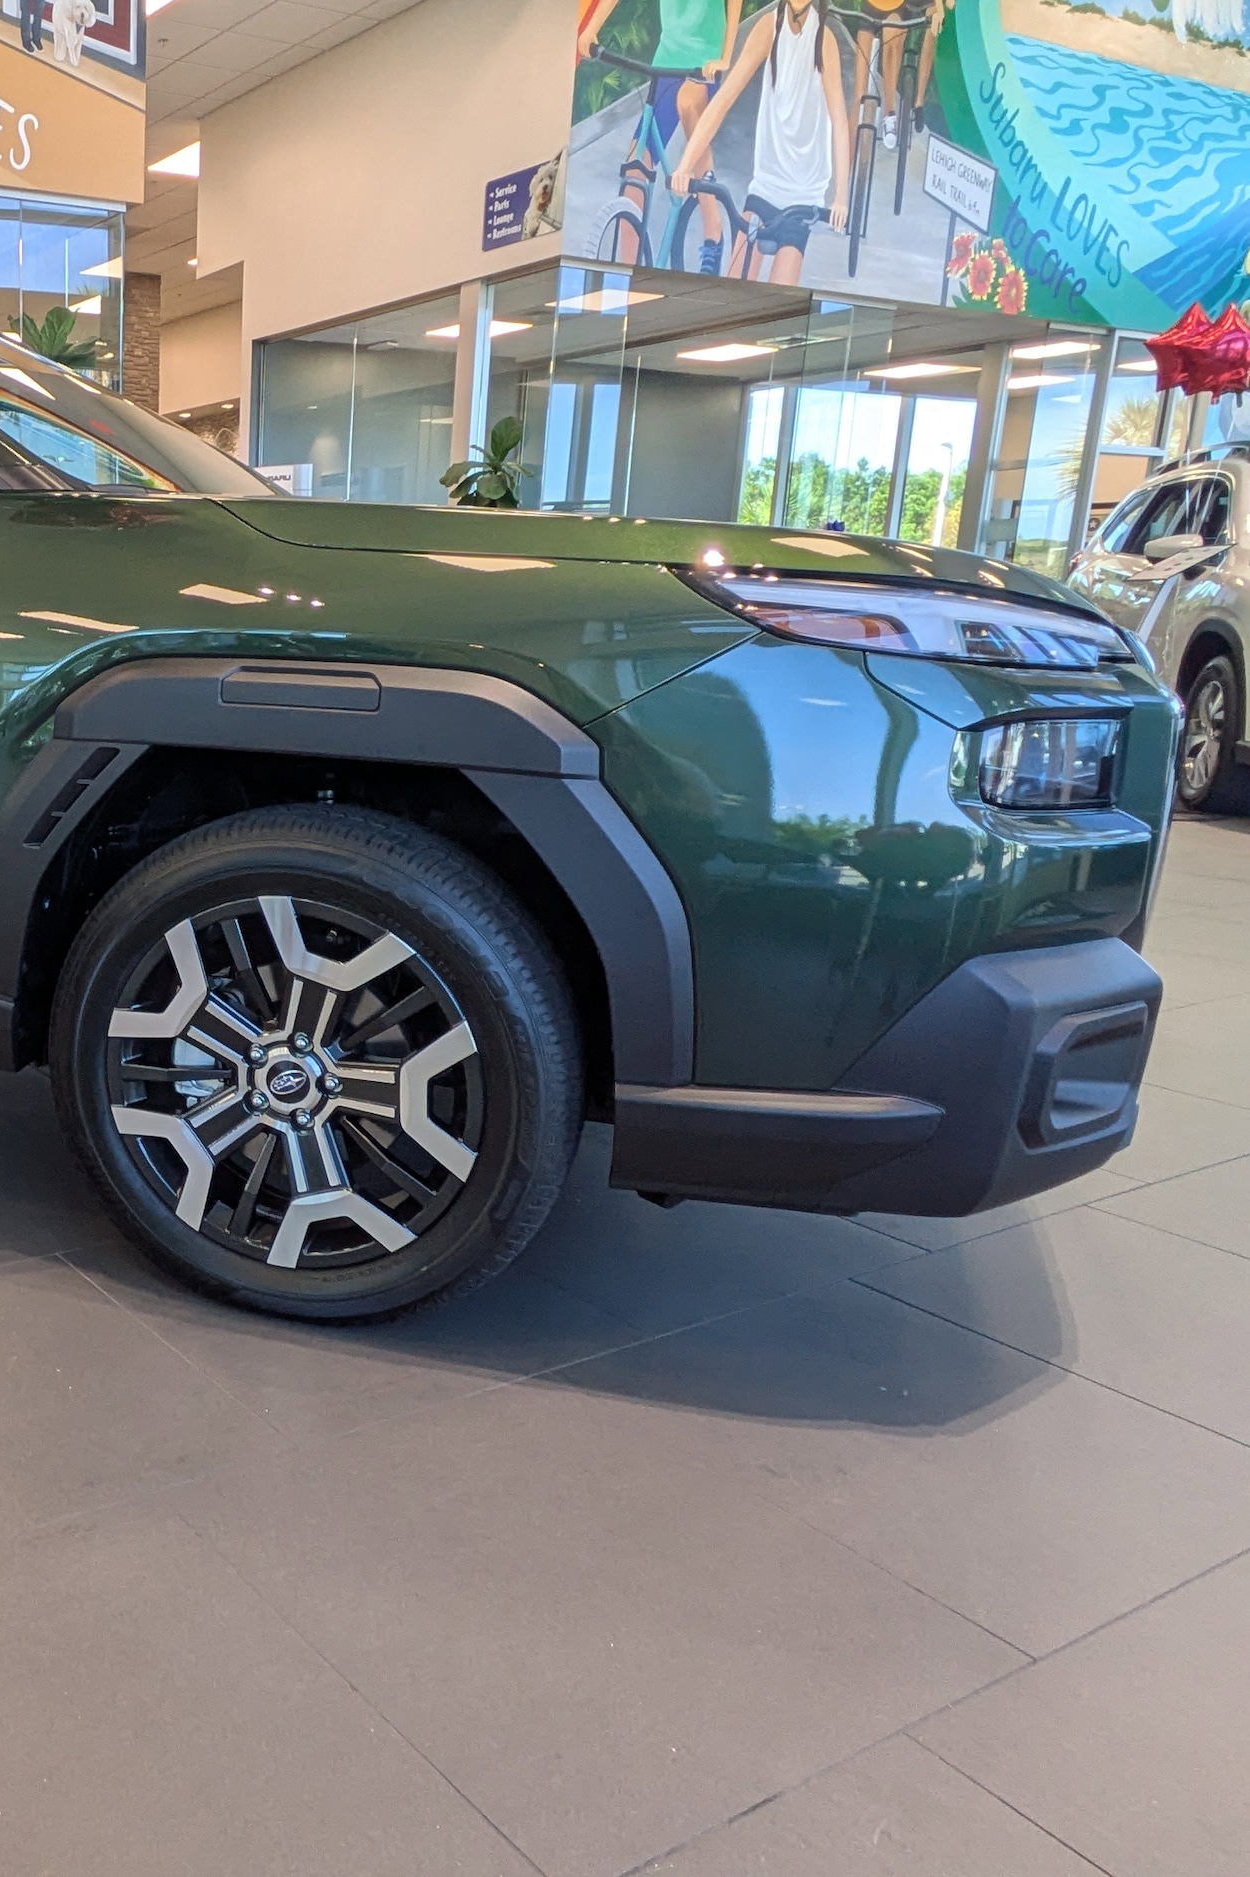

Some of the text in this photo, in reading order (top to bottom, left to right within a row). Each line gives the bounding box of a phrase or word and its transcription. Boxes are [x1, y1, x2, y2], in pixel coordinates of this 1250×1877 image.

[931, 149, 992, 193] LEHIGH GREENWAY
[979, 61, 1130, 288] Subaru LOVES
[495, 184, 517, 198] Service
[931, 173, 967, 208] RAIL TRAIL
[494, 199, 510, 212] Parts
[492, 224, 522, 240] Restrooms
[493, 213, 514, 226] Lounge
[1003, 195, 1087, 314] to Care
